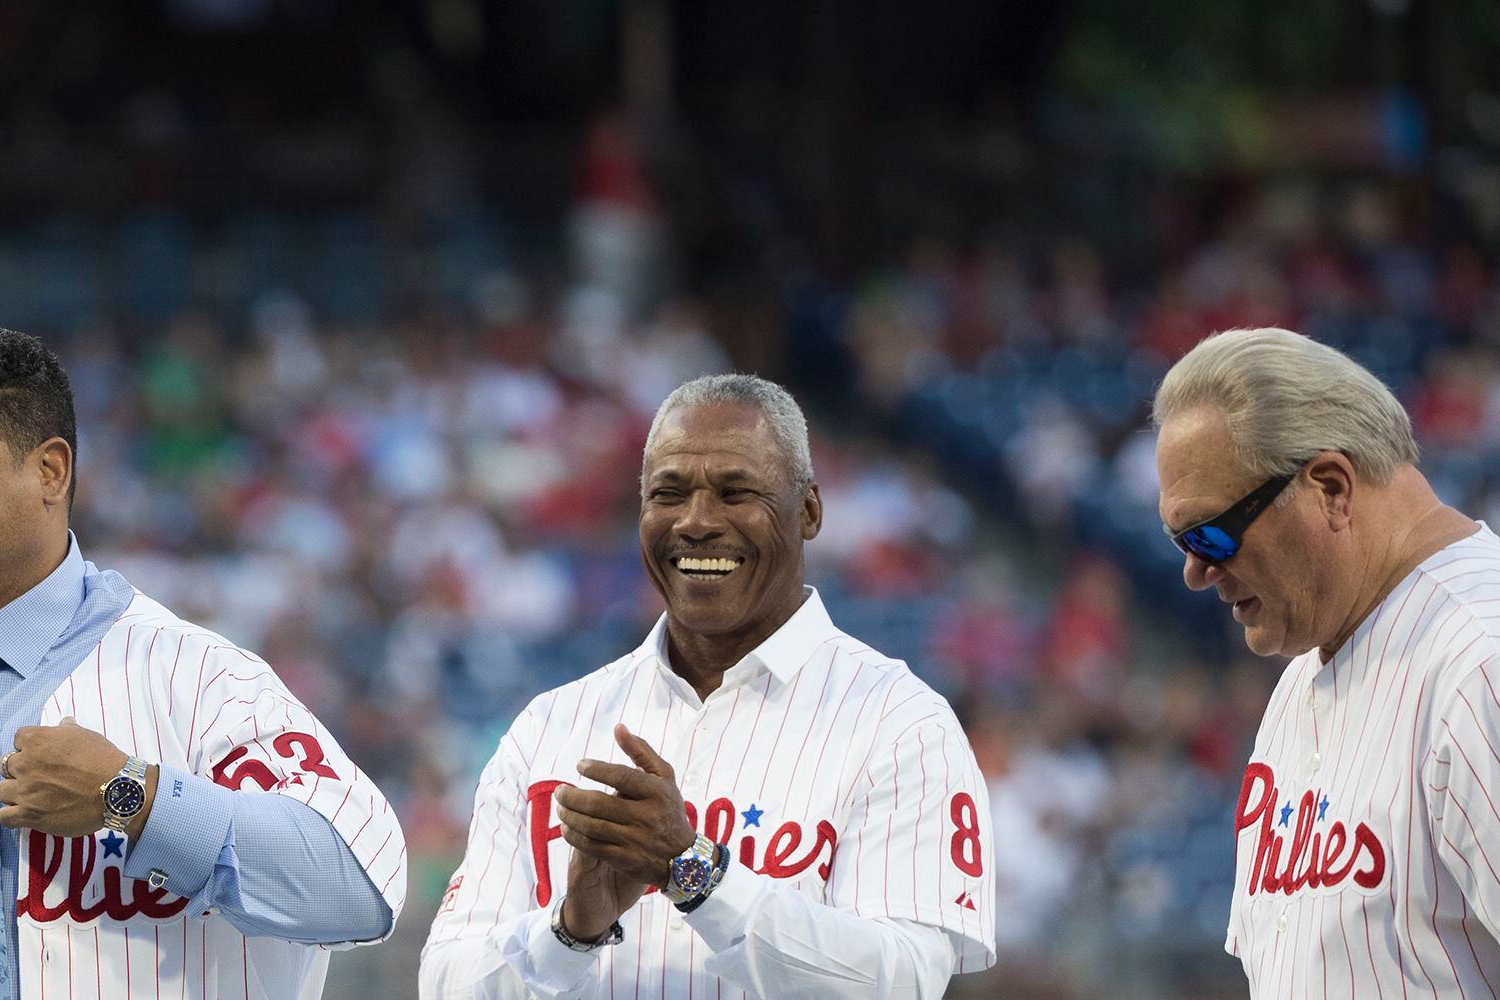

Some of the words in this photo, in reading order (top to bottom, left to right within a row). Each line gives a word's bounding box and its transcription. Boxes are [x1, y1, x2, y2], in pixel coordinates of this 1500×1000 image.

[17, 828, 209, 923] llie
[950, 792, 983, 878] 8
[1235, 762, 1385, 896] Philies
